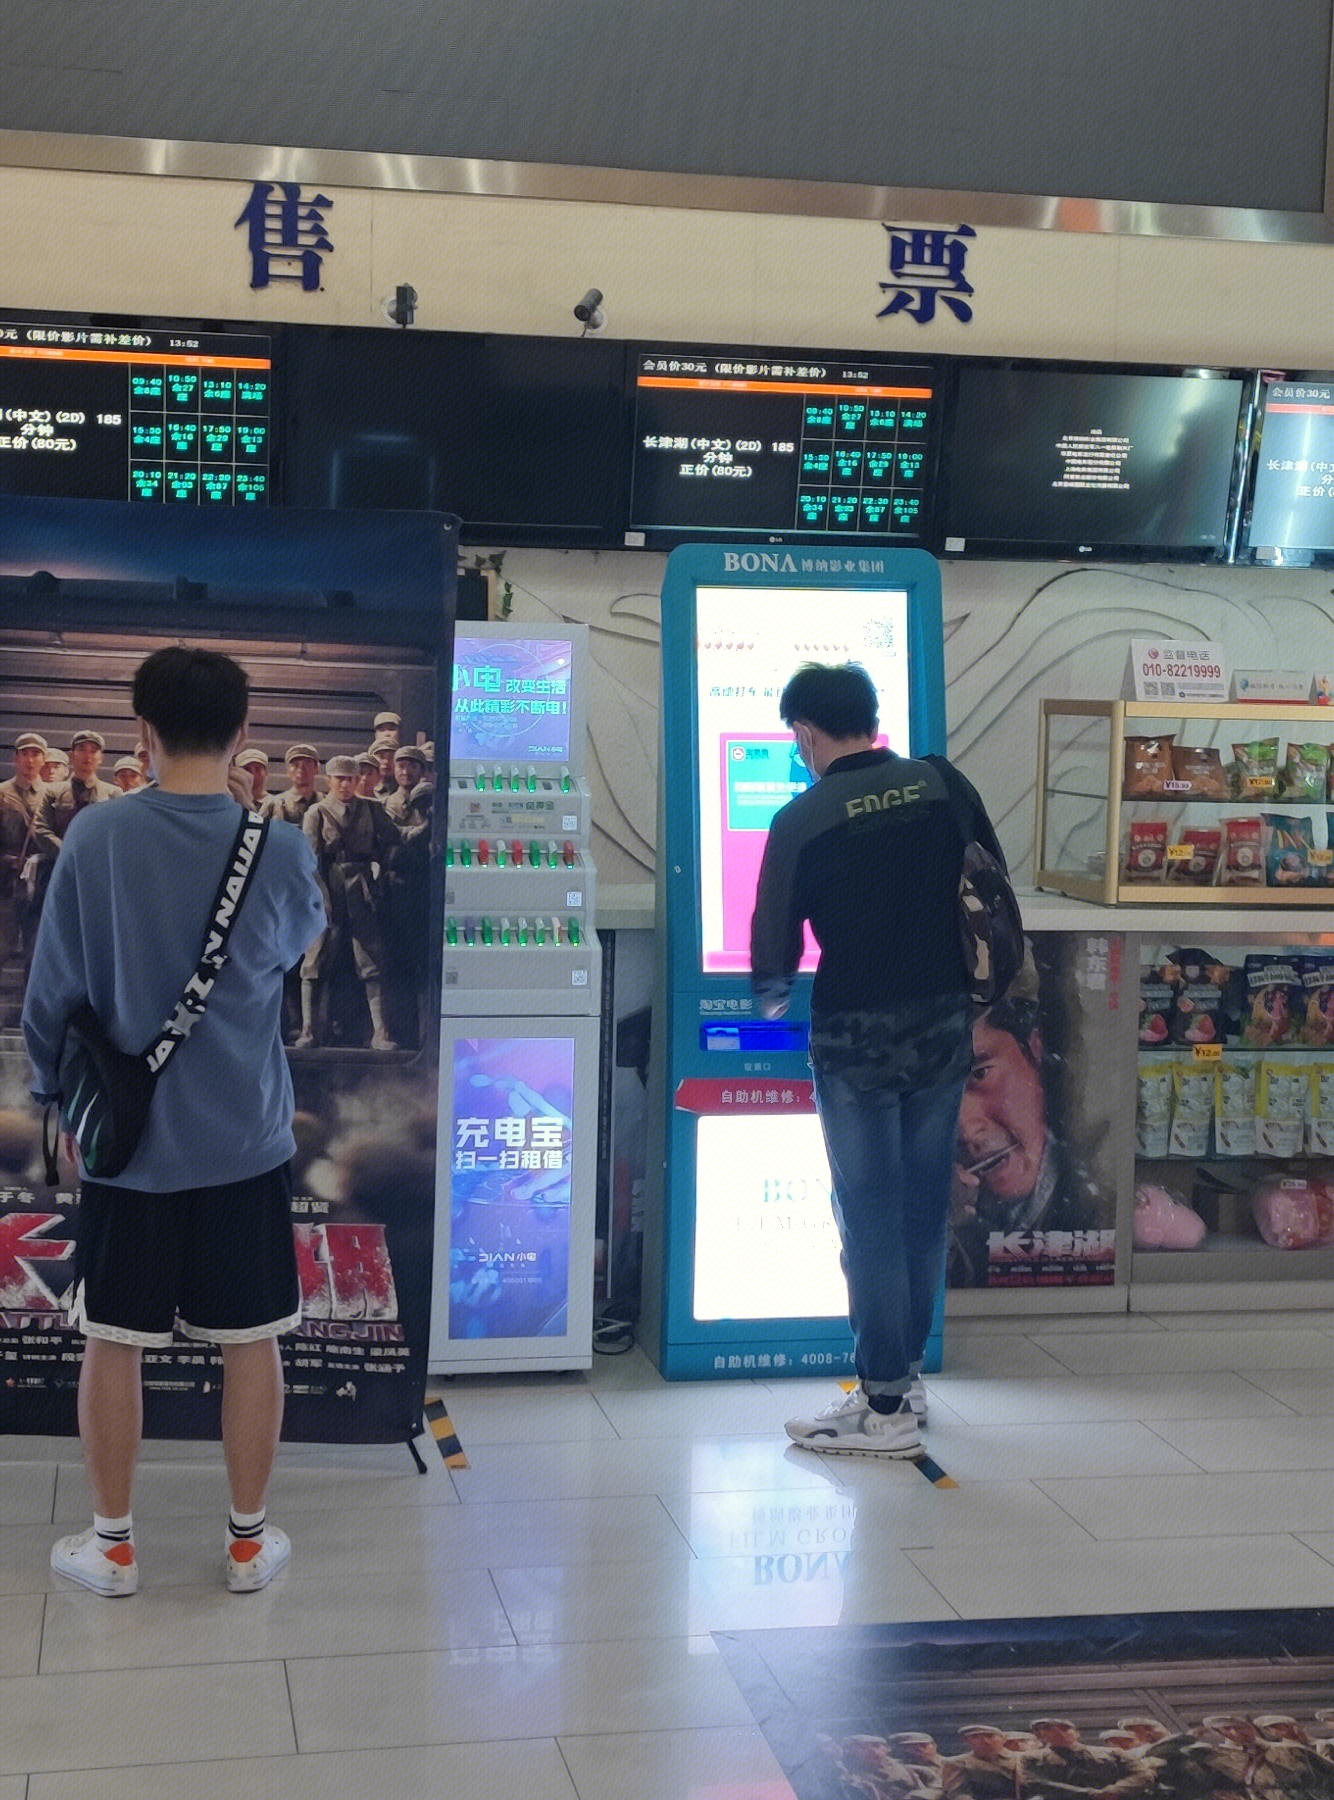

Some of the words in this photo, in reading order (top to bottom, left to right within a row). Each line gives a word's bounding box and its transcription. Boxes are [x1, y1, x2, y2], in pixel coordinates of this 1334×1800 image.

[235, 181, 334, 292] 售
[876, 221, 977, 325] 票
[643, 360, 707, 373] 会员价30元
[96, 414, 122, 425] 185
[21, 423, 54, 437] 分钟
[772, 442, 794, 452] 185
[703, 452, 733, 464] 分钟
[679, 464, 752, 477] 正价(80元)
[723, 552, 799, 574] BONA
[1142, 662, 1222, 679] 010-82219999
[505, 678, 566, 695] 改变生活
[698, 998, 754, 1012] 淘宝电影
[456, 1116, 563, 1149] 充电宝
[455, 1149, 563, 1170] 扫一扫租借
